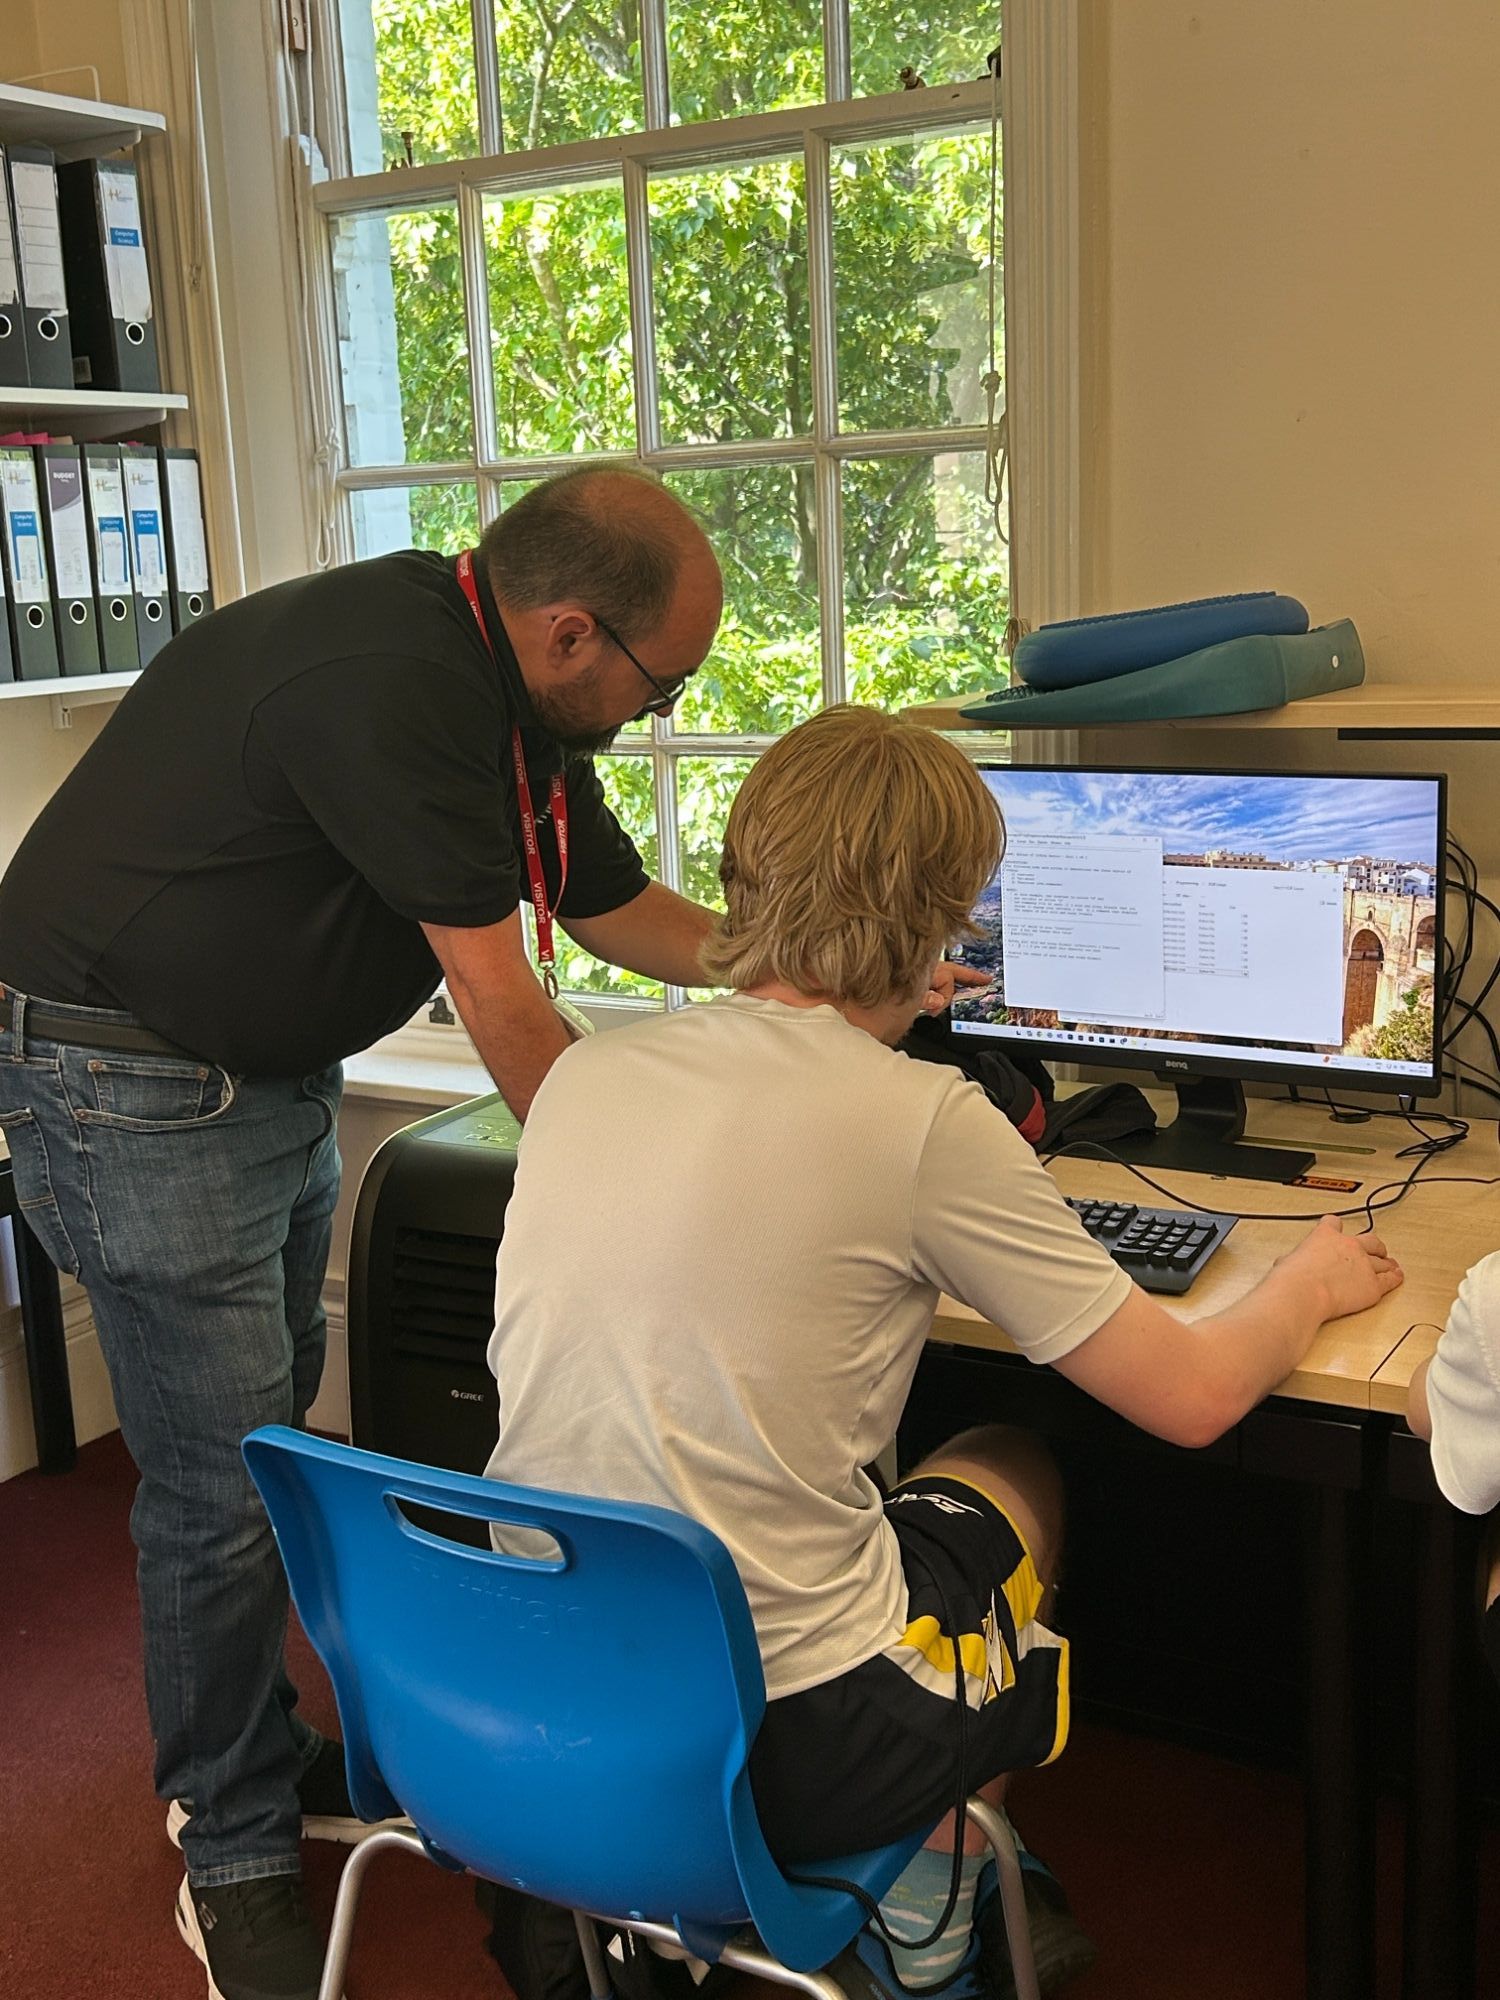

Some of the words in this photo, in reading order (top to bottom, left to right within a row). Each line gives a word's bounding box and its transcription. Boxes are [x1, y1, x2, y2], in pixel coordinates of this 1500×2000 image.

[513, 741, 525, 784] VISITOR
[522, 812, 536, 855] VISITOR
[556, 819, 568, 855] VISITOR
[533, 881, 546, 924] VISITOR
[1165, 1060, 1188, 1070] BenQ
[459, 1392, 485, 1401] GREE
